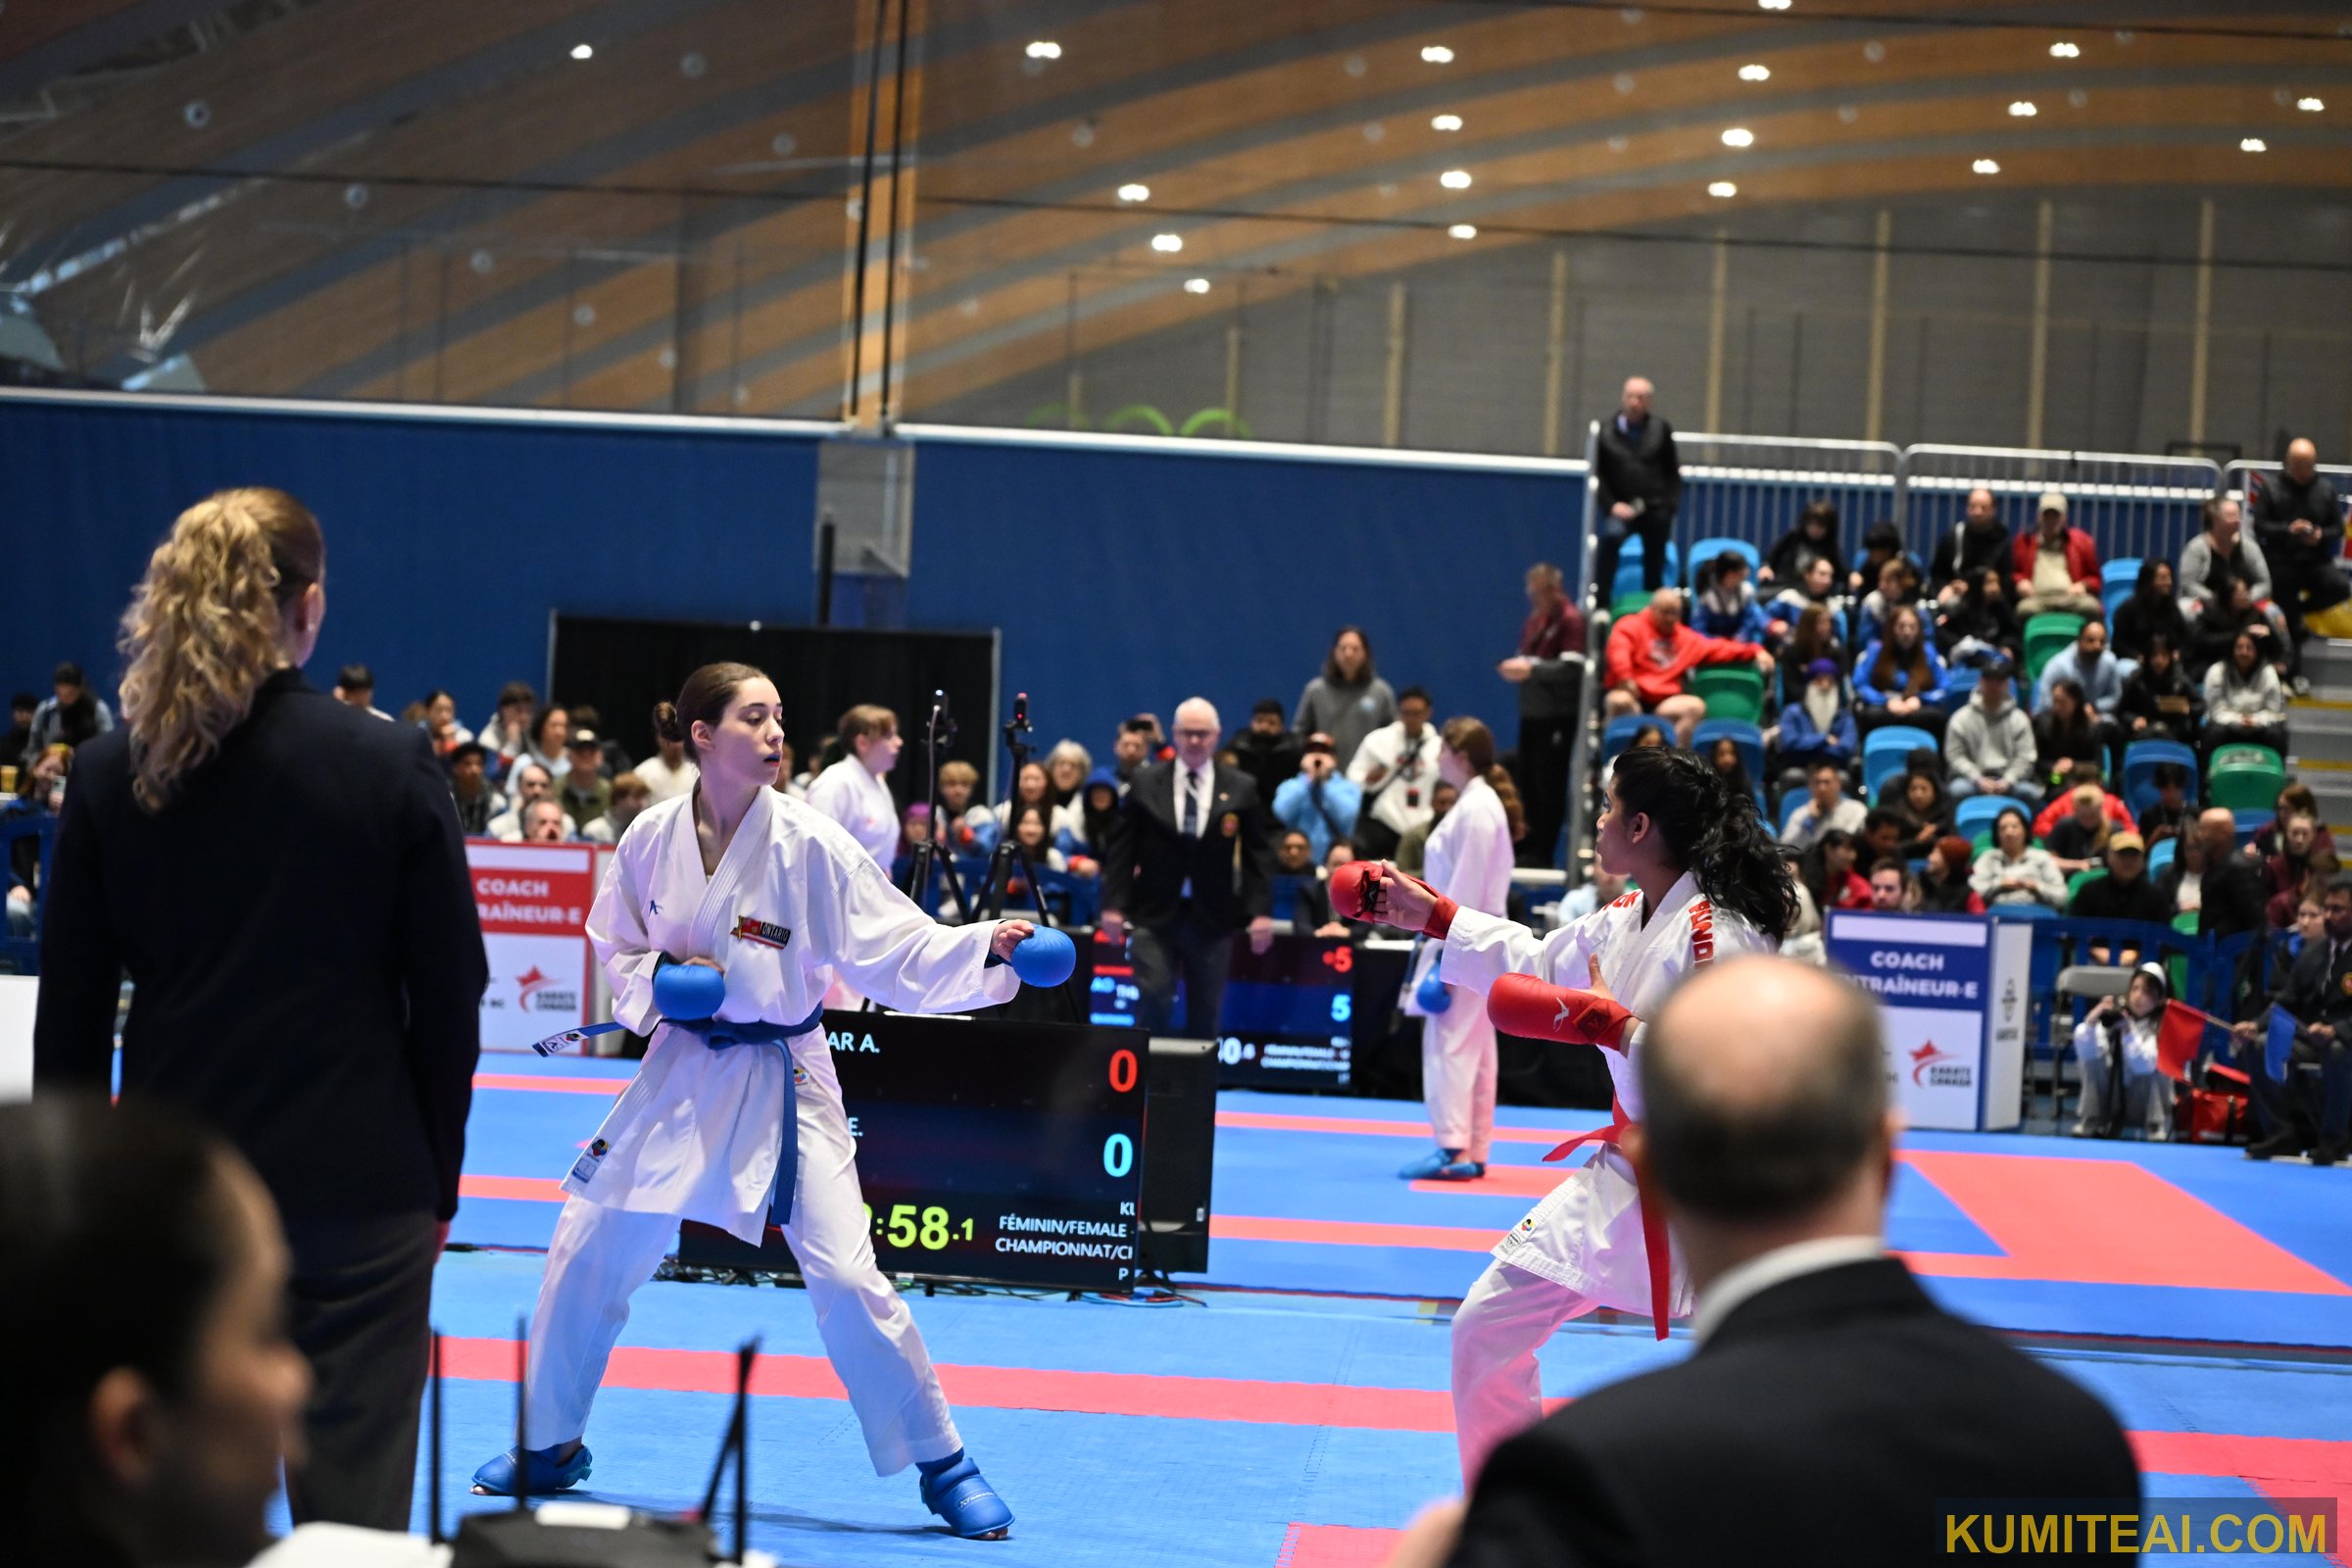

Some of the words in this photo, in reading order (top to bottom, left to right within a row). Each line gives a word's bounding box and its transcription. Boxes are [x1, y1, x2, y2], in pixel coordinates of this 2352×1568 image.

[476, 878, 549, 898] COACH
[762, 923, 789, 942] ONTARIO
[1334, 946, 1351, 972] 5
[1870, 951, 1944, 971] COACH
[1332, 994, 1351, 1022] 5
[827, 1031, 855, 1052] AR
[858, 1033, 880, 1054] A.
[1108, 1049, 1138, 1093] 0
[1102, 1133, 1133, 1177] 0
[999, 1213, 1127, 1238] FÉMININ/FEMALE
